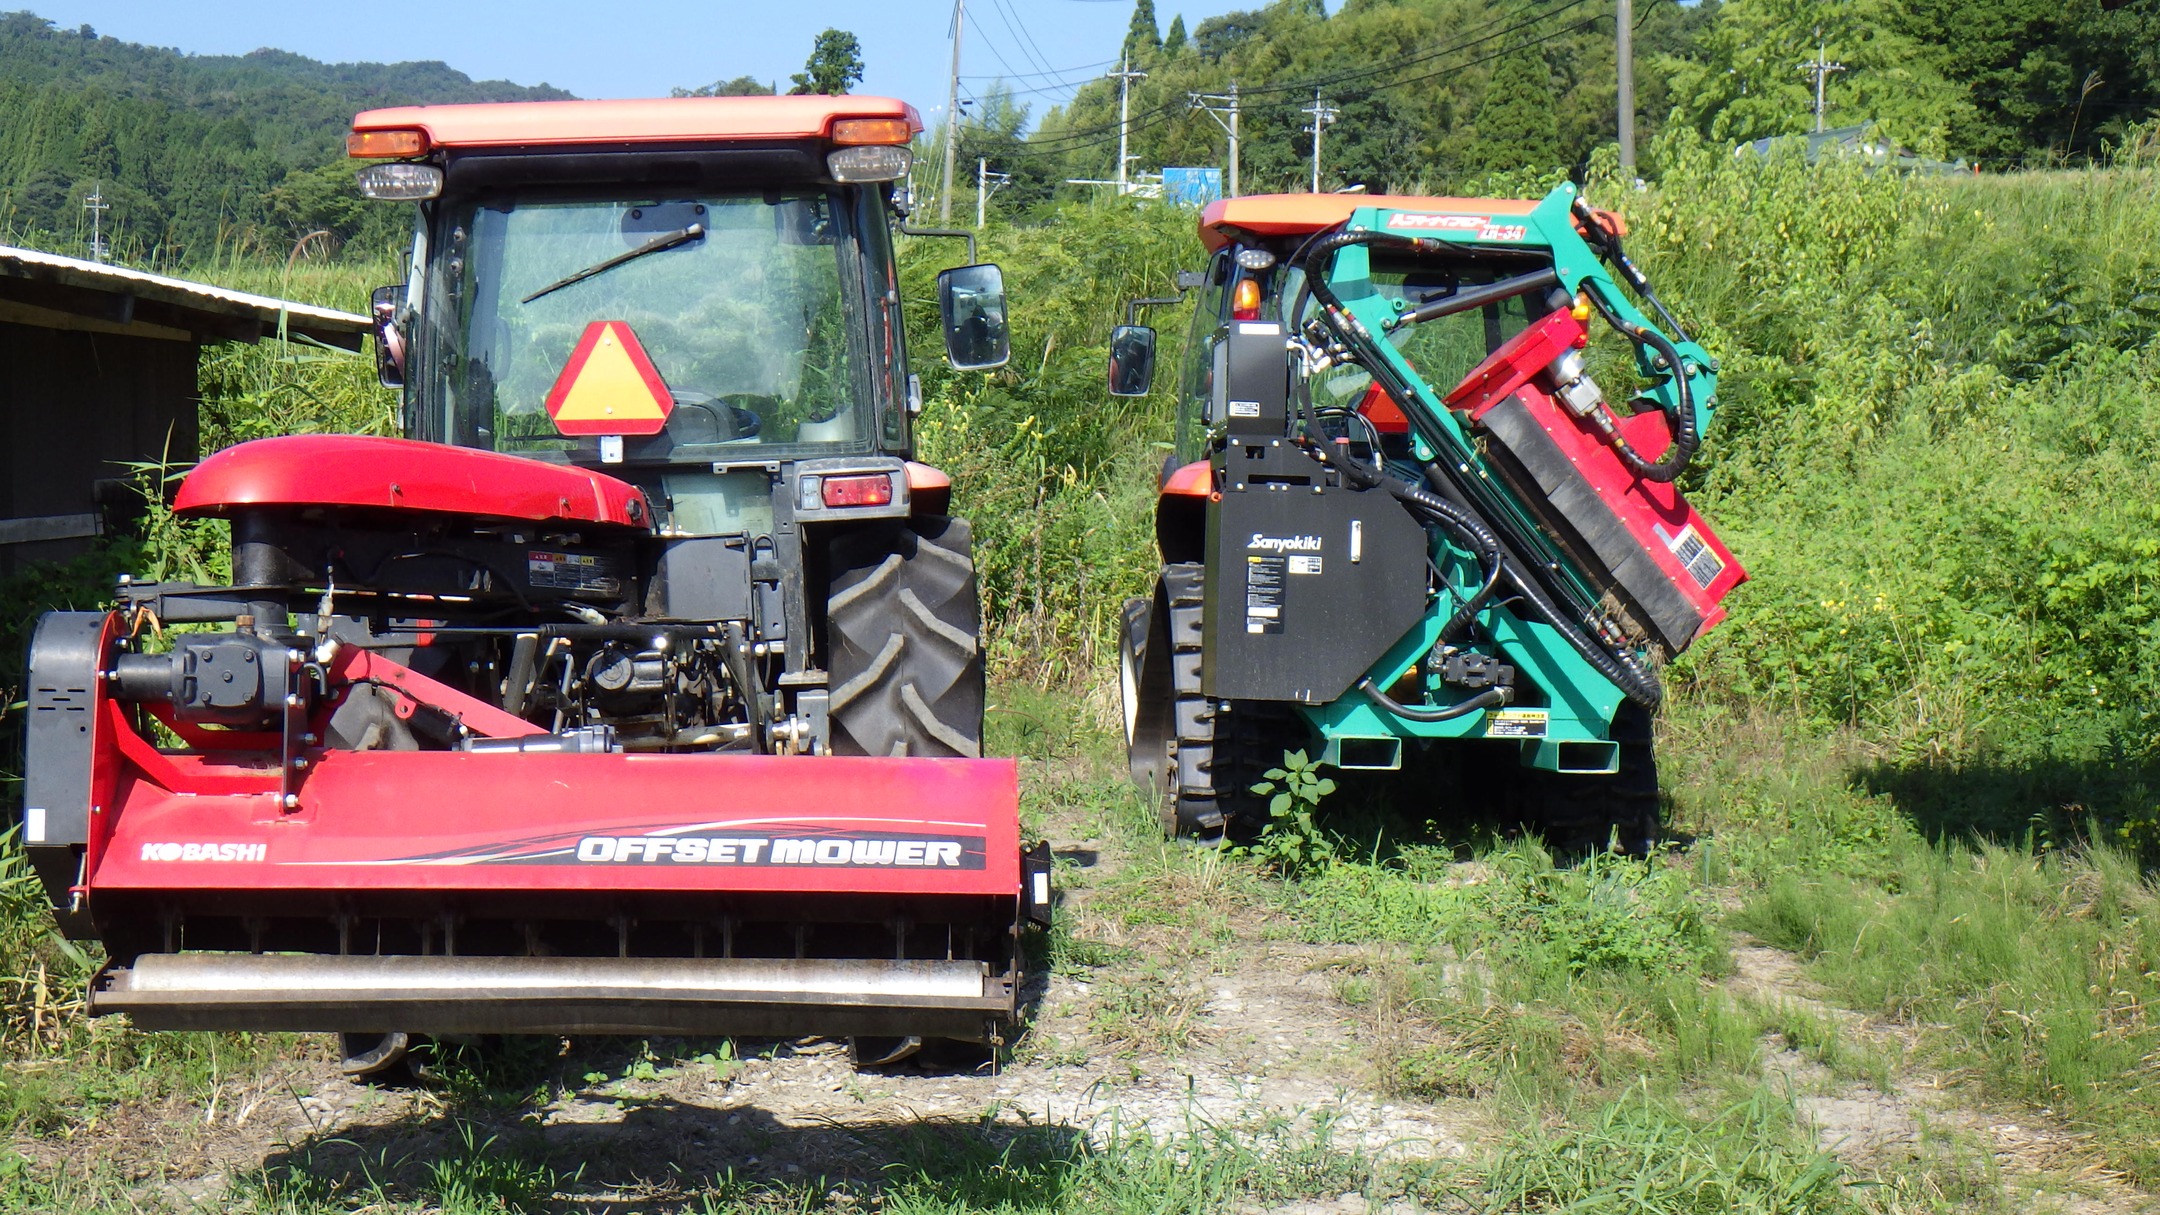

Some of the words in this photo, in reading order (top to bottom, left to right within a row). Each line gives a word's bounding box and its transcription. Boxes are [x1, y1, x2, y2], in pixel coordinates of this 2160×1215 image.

[1480, 224, 1523, 240] ZH-34
[1247, 533, 1322, 553] Sanyokiki
[141, 842, 267, 862] KOBASHI
[577, 837, 768, 863] OFFSET
[770, 839, 962, 866] MOWER
